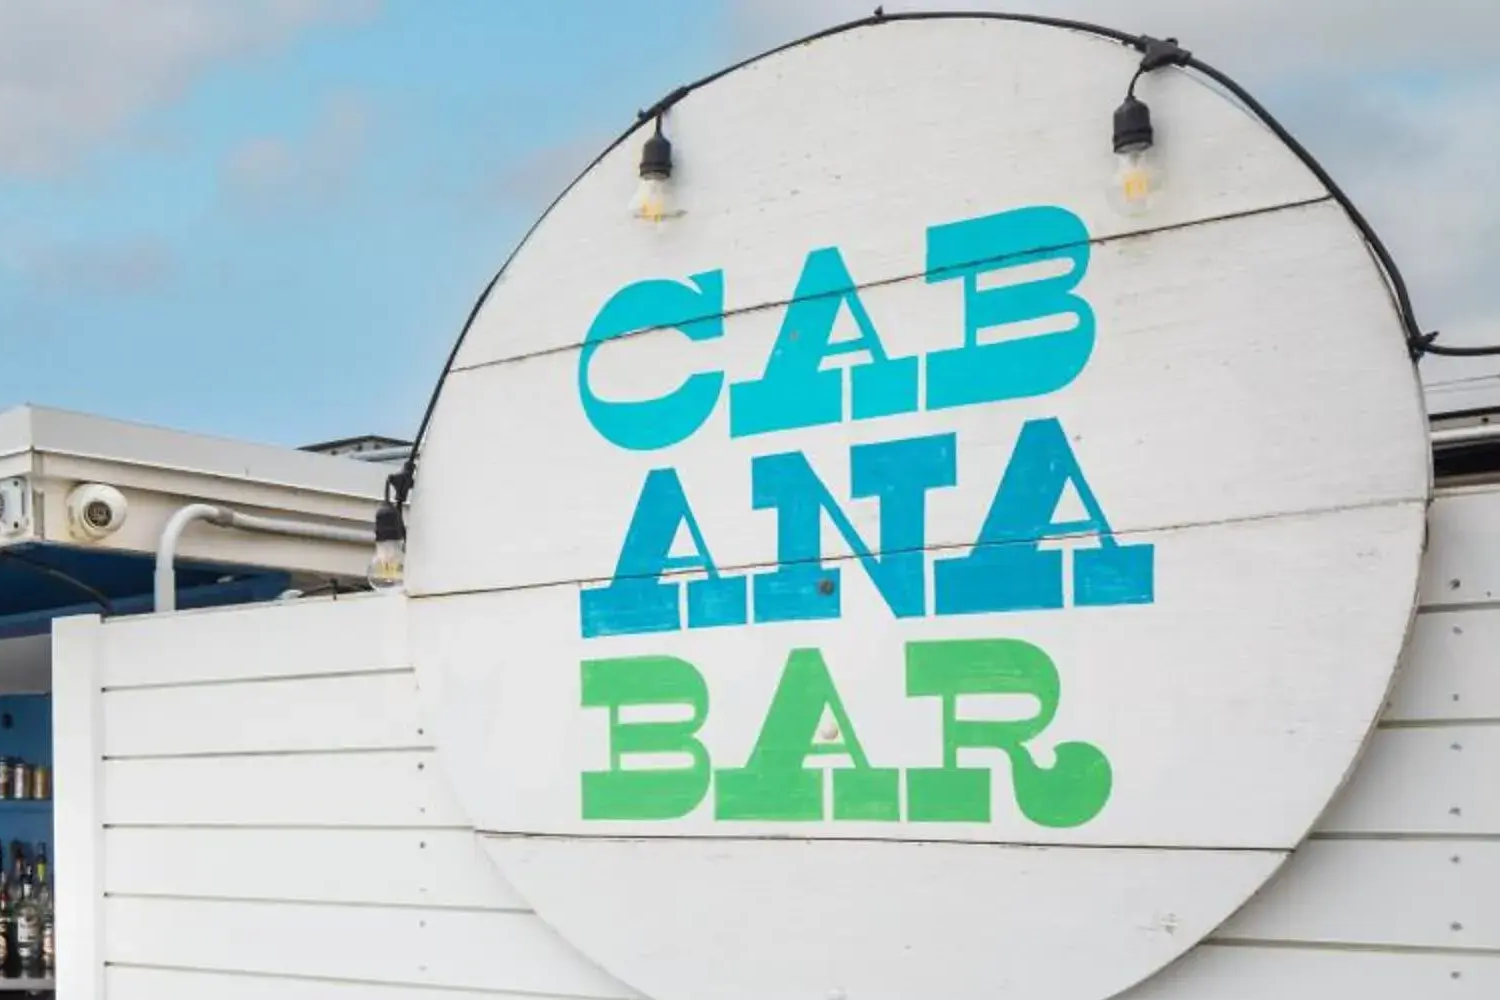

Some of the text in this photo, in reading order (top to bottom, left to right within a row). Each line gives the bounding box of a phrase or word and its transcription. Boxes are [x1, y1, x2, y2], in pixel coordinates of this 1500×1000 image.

[578, 205, 1097, 451] CAB
[580, 417, 1155, 638] ANA
[580, 638, 1112, 828] BAR
